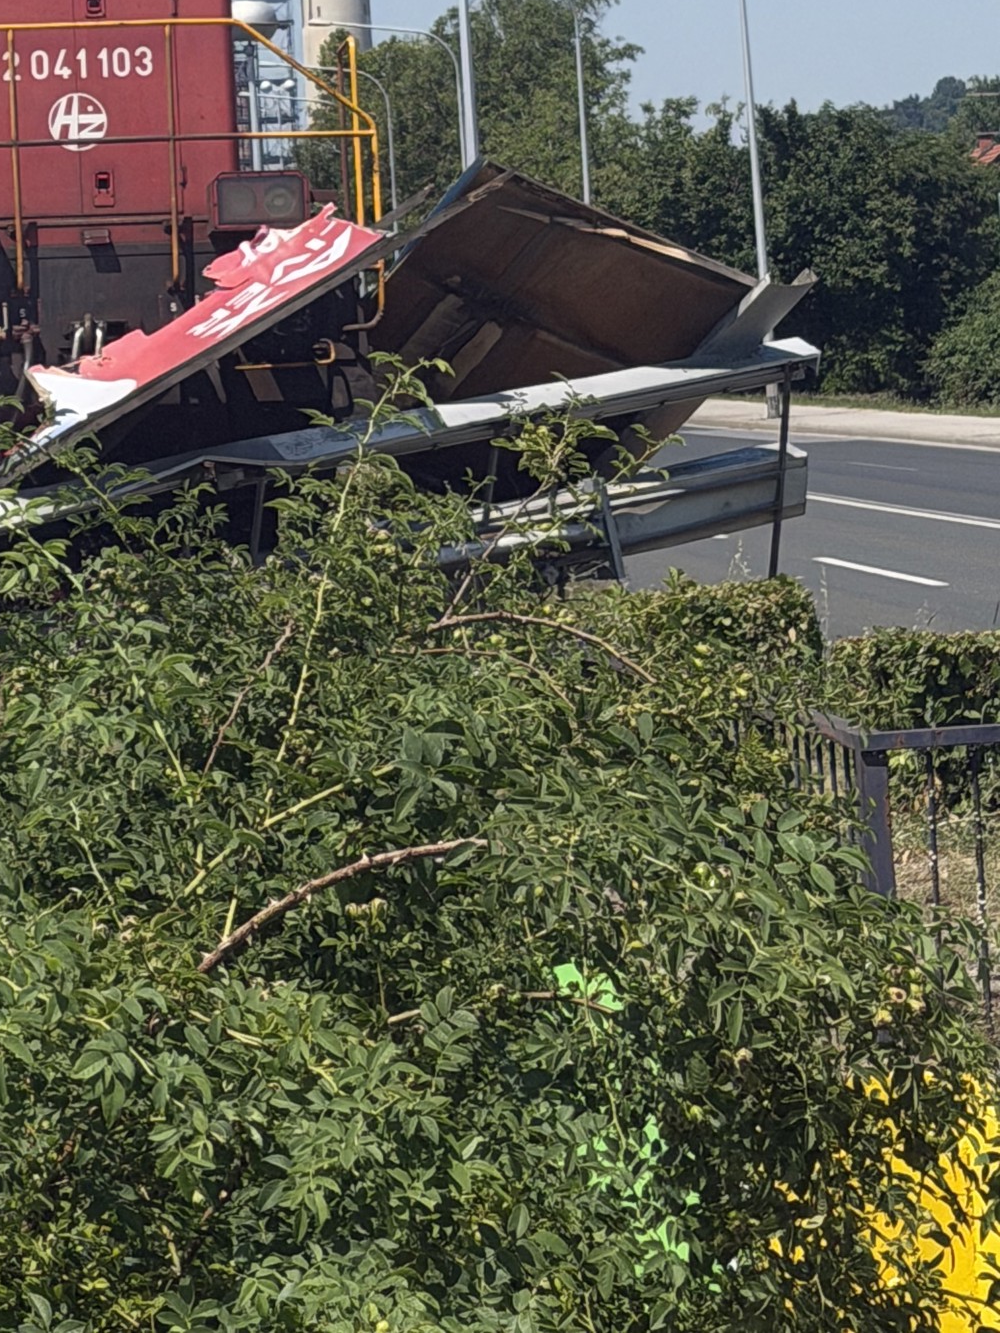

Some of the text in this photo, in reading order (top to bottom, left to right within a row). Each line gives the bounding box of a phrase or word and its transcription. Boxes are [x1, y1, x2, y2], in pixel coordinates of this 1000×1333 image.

[2, 46, 153, 81] 2 041 103
[186, 219, 338, 336] IVER
